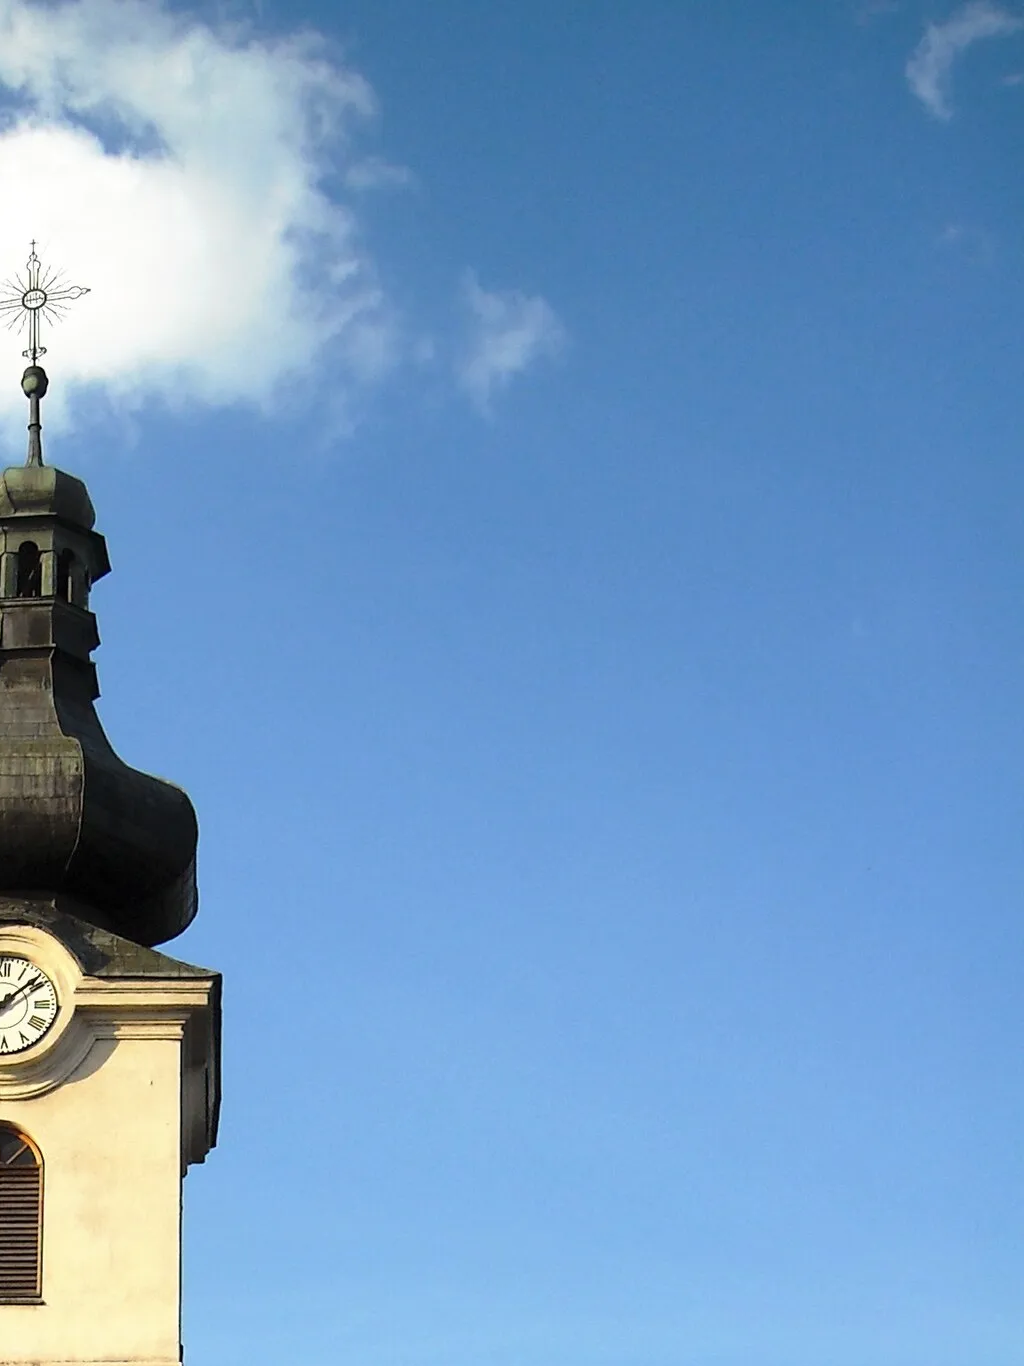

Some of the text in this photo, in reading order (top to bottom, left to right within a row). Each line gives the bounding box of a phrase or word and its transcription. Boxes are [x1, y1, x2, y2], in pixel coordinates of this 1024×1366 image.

[17, 967, 27, 981] I
[34, 1000, 51, 1009] III
[27, 1015, 47, 1031] IIII
[19, 1031, 30, 1044] V
